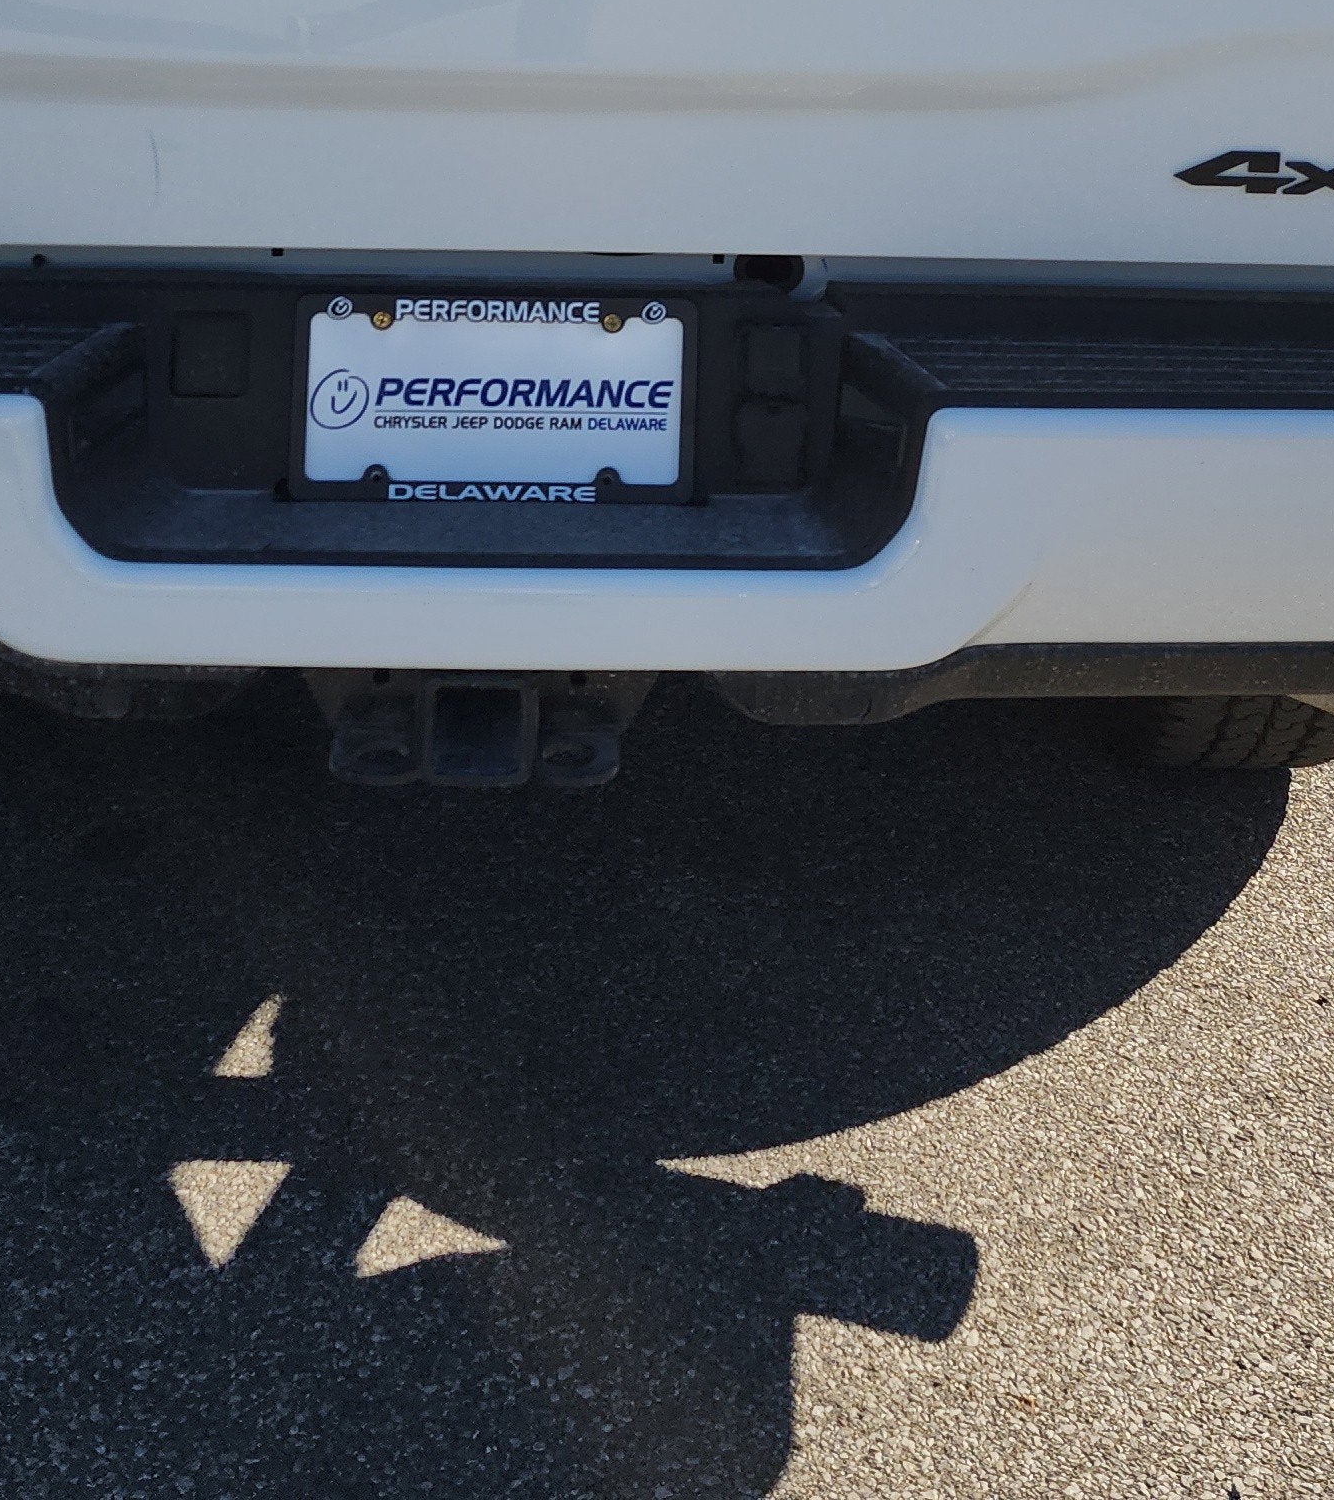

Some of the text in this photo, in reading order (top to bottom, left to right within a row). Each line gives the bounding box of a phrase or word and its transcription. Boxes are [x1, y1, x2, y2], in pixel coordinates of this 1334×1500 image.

[395, 299, 600, 323] PERFORMANCE
[375, 377, 674, 409] PERFORMANCE
[373, 415, 667, 432] CHRYSLER JEEP DODGE RAM DELAWARE
[388, 484, 597, 502] DELAWARE
